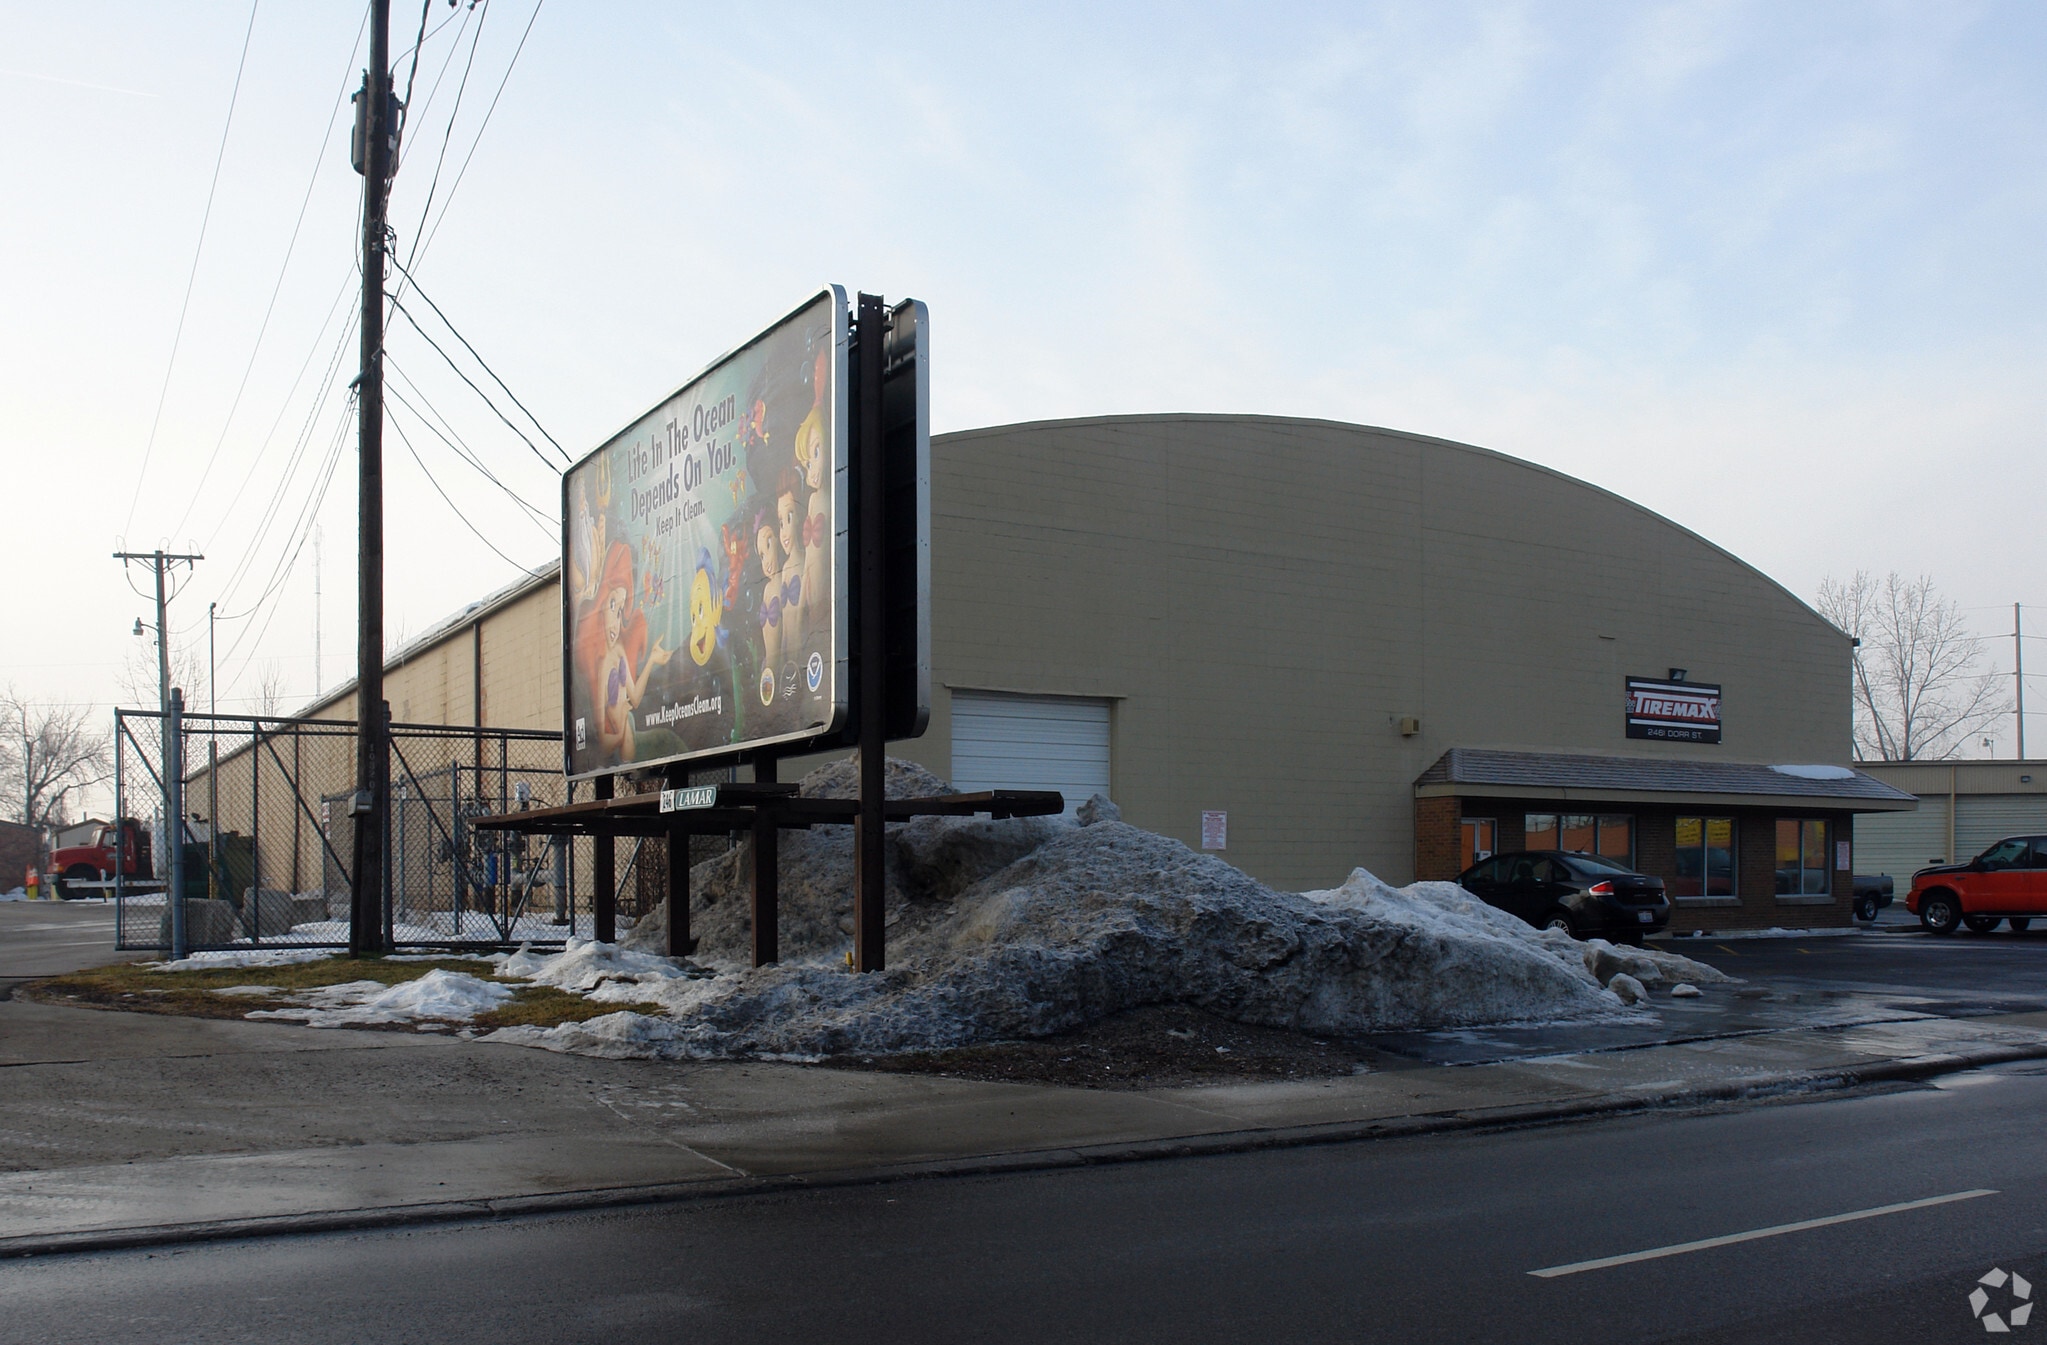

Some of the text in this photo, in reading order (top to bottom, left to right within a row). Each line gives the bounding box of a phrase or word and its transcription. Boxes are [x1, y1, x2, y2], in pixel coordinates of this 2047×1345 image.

[627, 393, 735, 483] Life In The Ocean
[631, 438, 736, 525] Depends On You.
[655, 499, 706, 537] Keep It Clean.
[645, 694, 721, 727] www.KeepOceansClean.org
[1633, 691, 1718, 719] TIREMAX
[1667, 730, 1690, 738] DORR
[679, 789, 713, 807] LAMAR
